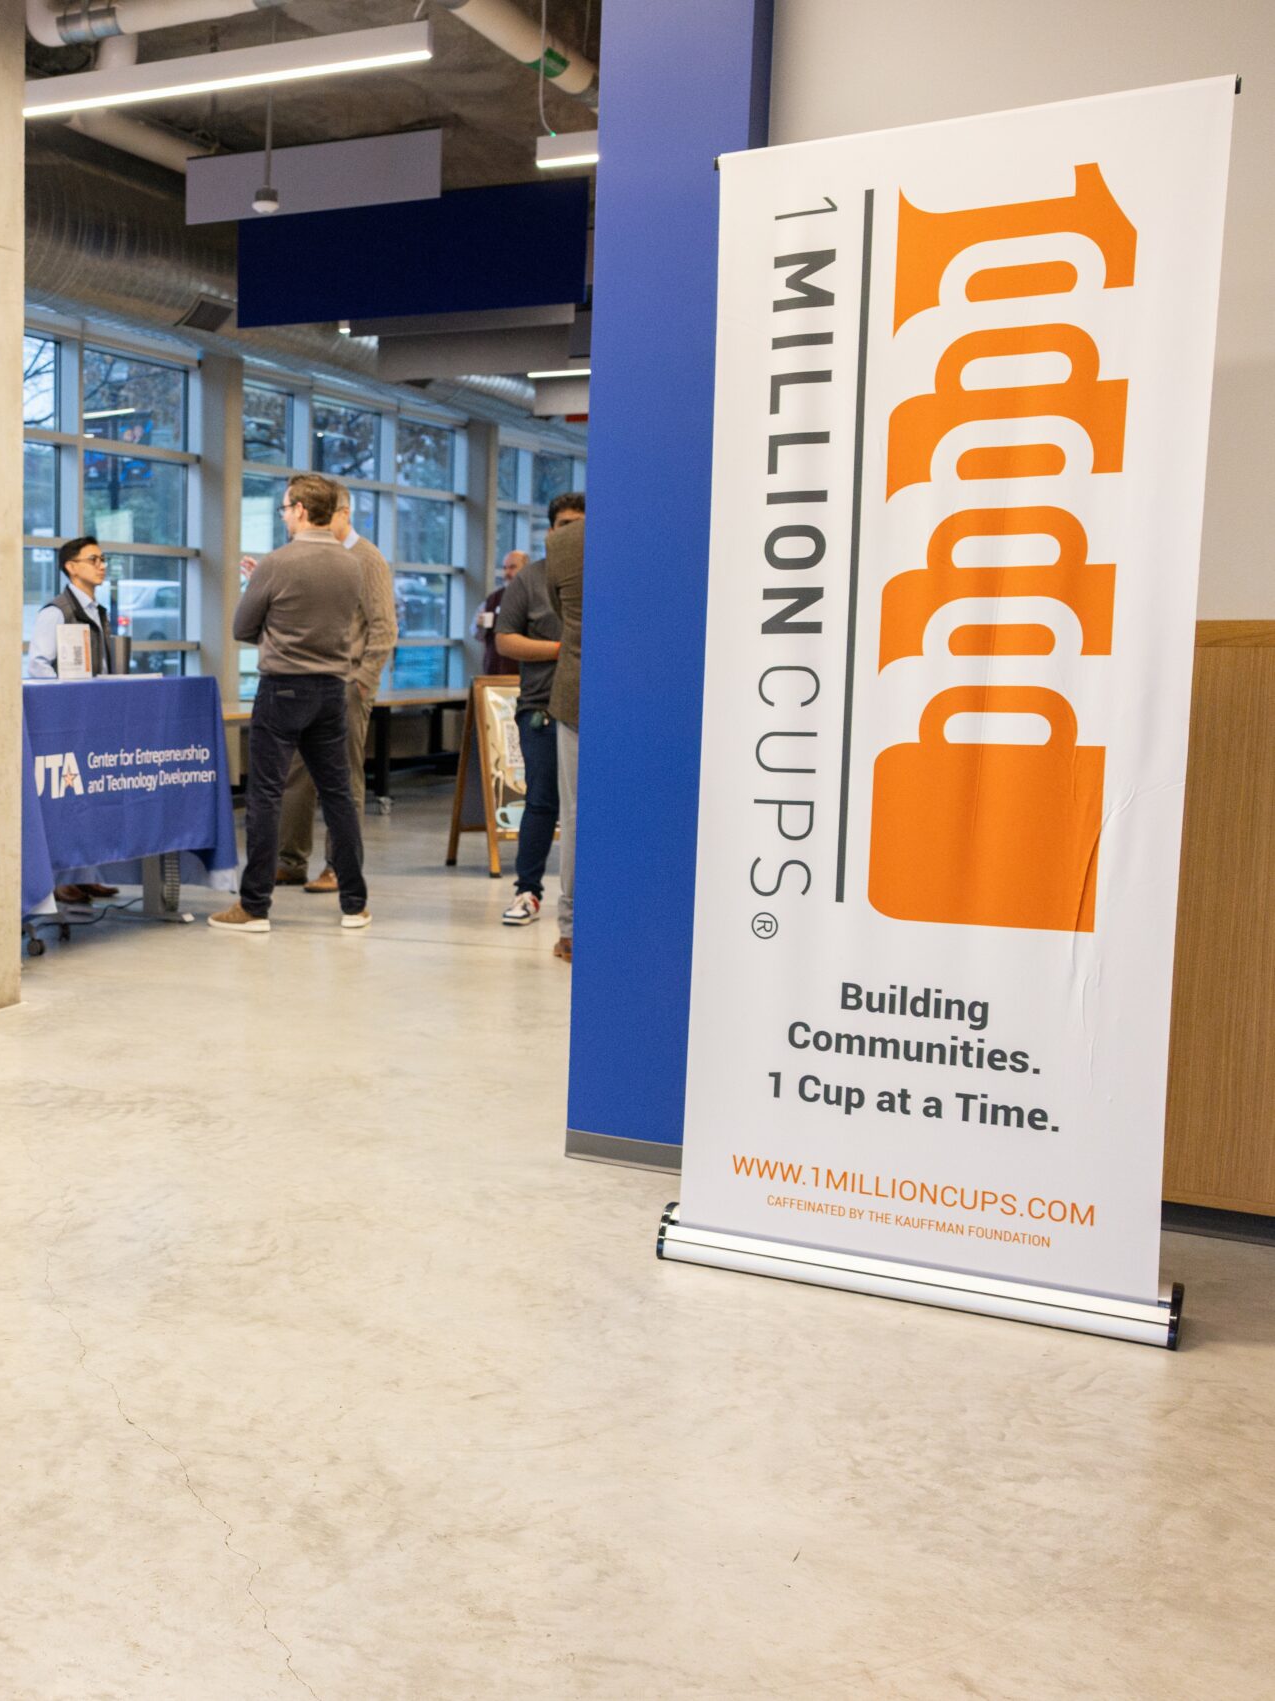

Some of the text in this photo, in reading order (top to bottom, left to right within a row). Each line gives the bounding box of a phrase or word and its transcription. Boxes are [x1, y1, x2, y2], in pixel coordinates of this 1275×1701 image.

[774, 196, 838, 221] 1
[87, 751, 118, 769] Center
[119, 749, 134, 766] for
[87, 774, 104, 794] and
[158, 768, 217, 787] Developmen
[840, 982, 990, 1031] Building
[787, 1021, 1041, 1075] Communities.
[768, 1071, 1059, 1132] 1 Cup at a Time.
[731, 1154, 1096, 1227] WWW.1MILLIONCUPS.COM
[766, 1194, 1051, 1248] CAFFEINATED BY THE KAUFFMAN FOUNDATION
